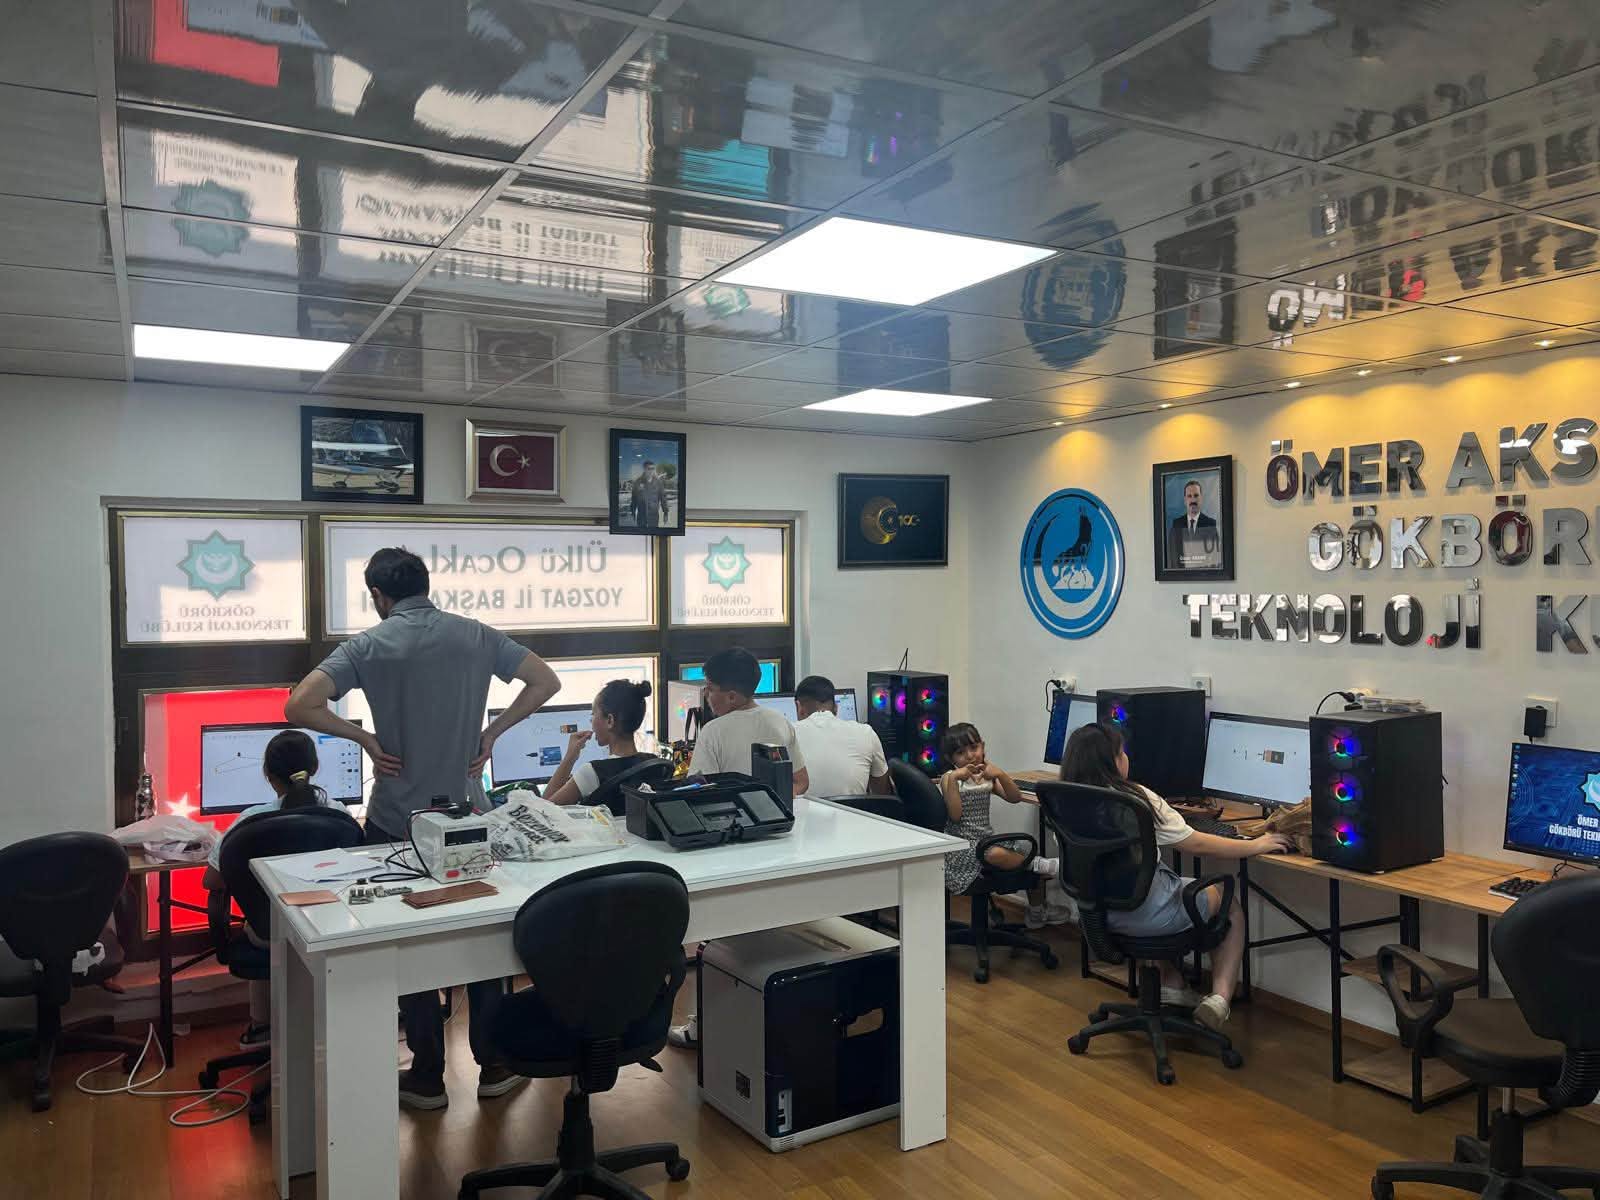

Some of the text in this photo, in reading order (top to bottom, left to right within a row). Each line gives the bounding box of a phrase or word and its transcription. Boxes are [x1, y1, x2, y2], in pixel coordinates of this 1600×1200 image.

[1266, 417, 1599, 501] ÖMER AKS
[1308, 494, 1600, 572] GÖKBÖR
[1182, 577, 1482, 649] TEKNOLOJİ
